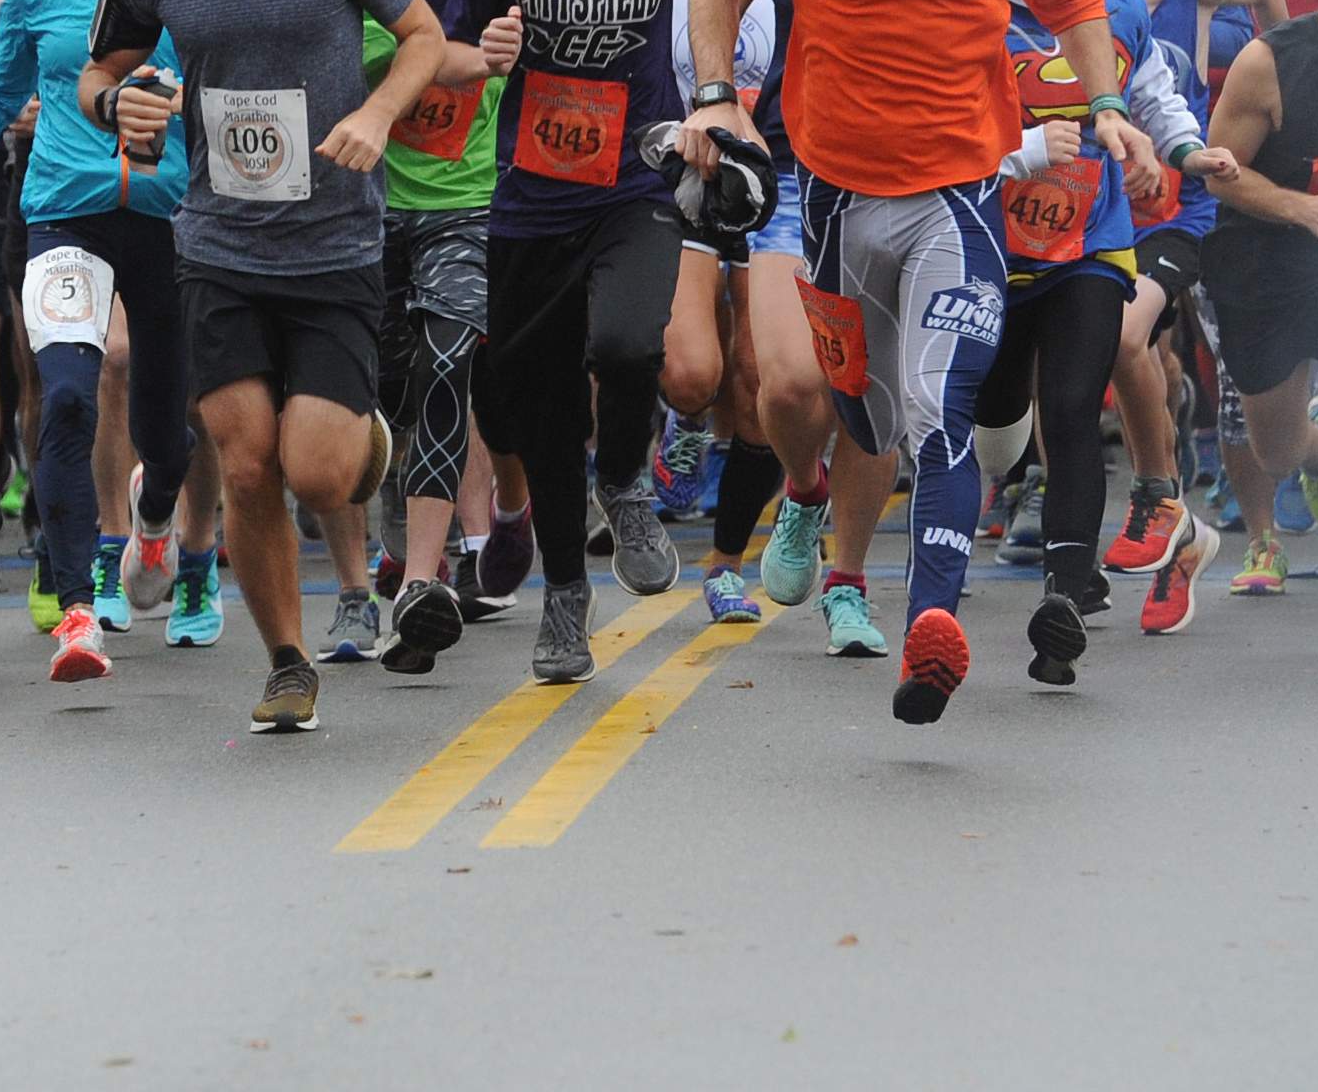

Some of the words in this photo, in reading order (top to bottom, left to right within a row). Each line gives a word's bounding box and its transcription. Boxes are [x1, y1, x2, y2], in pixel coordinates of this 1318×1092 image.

[223, 94, 250, 108] Cape
[254, 94, 277, 106] Cod
[404, 98, 457, 129] 145
[223, 111, 279, 123] Marathon
[228, 127, 278, 154] 106
[534, 119, 601, 155] 4145
[1008, 196, 1075, 232] 4142
[62, 277, 76, 300] 5
[932, 293, 1000, 334] UNH
[926, 317, 996, 343] WILDCATS
[922, 526, 972, 557] UNH
